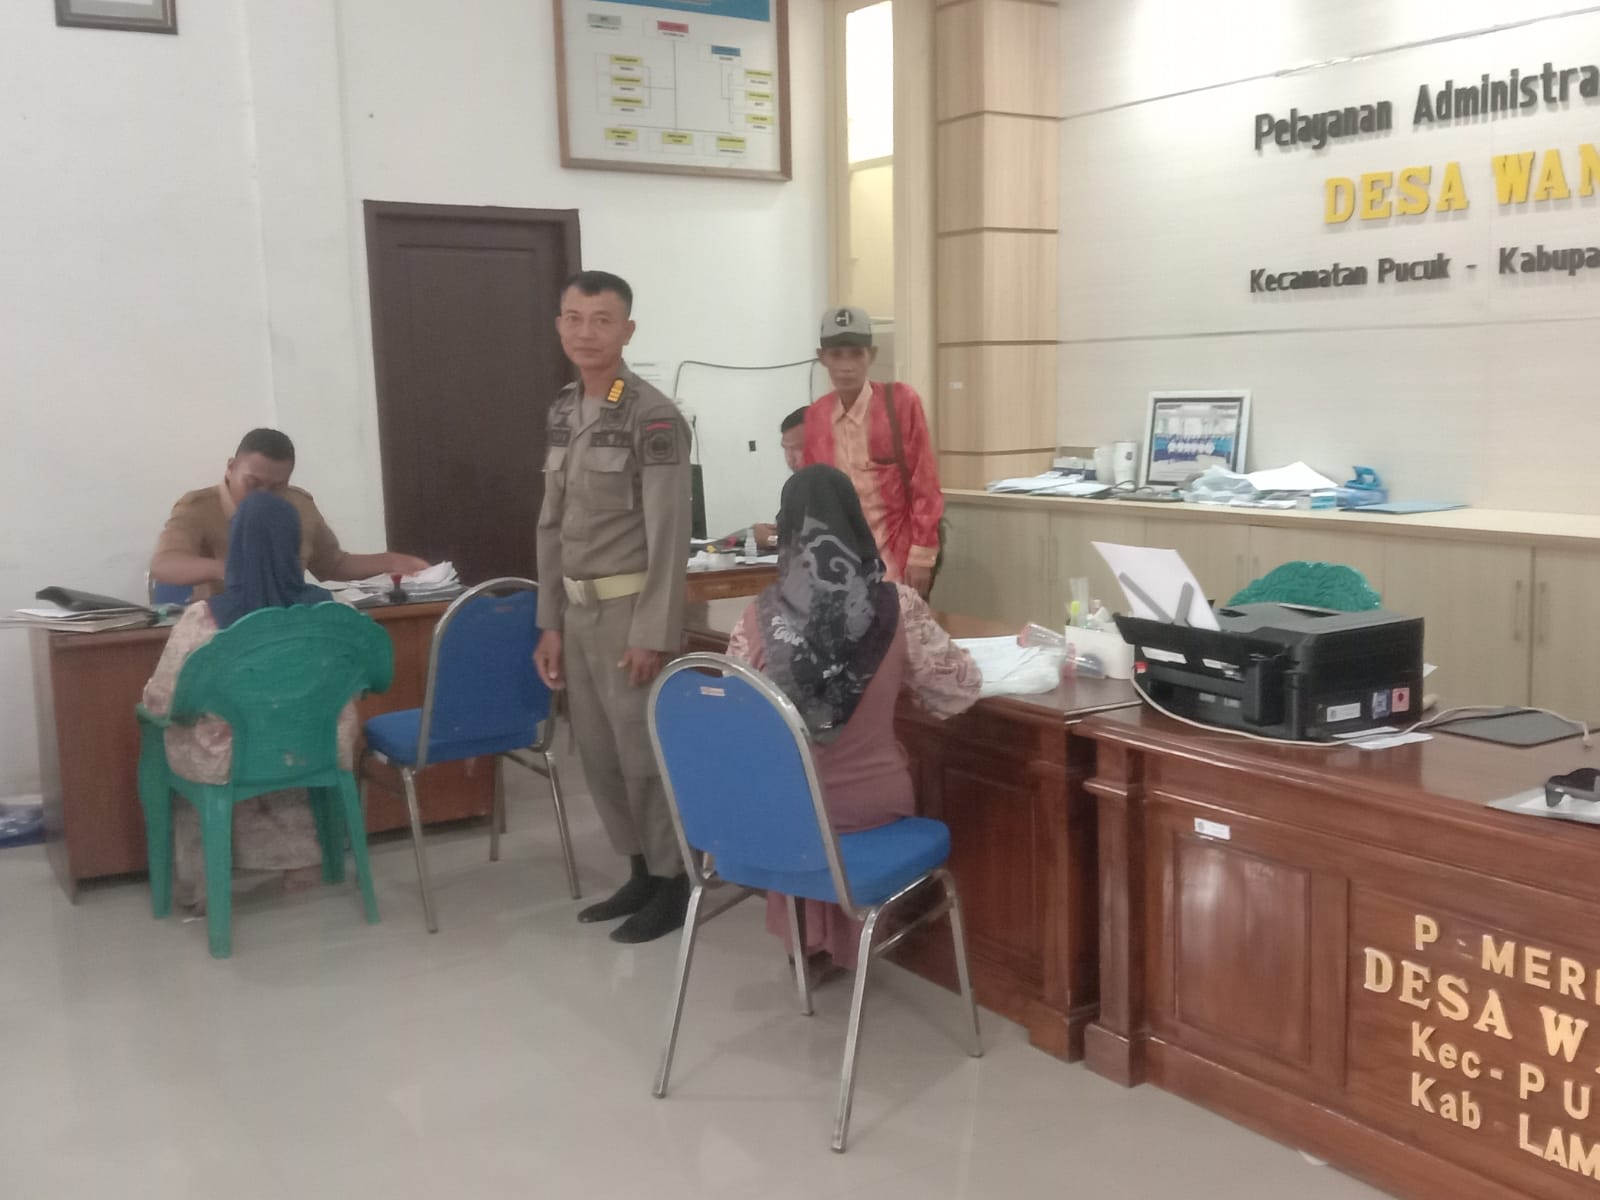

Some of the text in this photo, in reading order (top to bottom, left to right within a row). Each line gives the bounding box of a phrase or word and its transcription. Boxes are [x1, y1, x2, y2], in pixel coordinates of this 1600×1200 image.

[1254, 62, 1600, 151] Pelayanan Administra
[1324, 161, 1469, 225] DESA
[1250, 263, 1368, 293] Kecamatan
[1377, 252, 1451, 284] Pucuk
[1499, 245, 1600, 276] Kabupa
[1363, 947, 1600, 1074] DESA W
[1411, 1072, 1600, 1182] Kab LAM
[1519, 1062, 1591, 1120] PU
